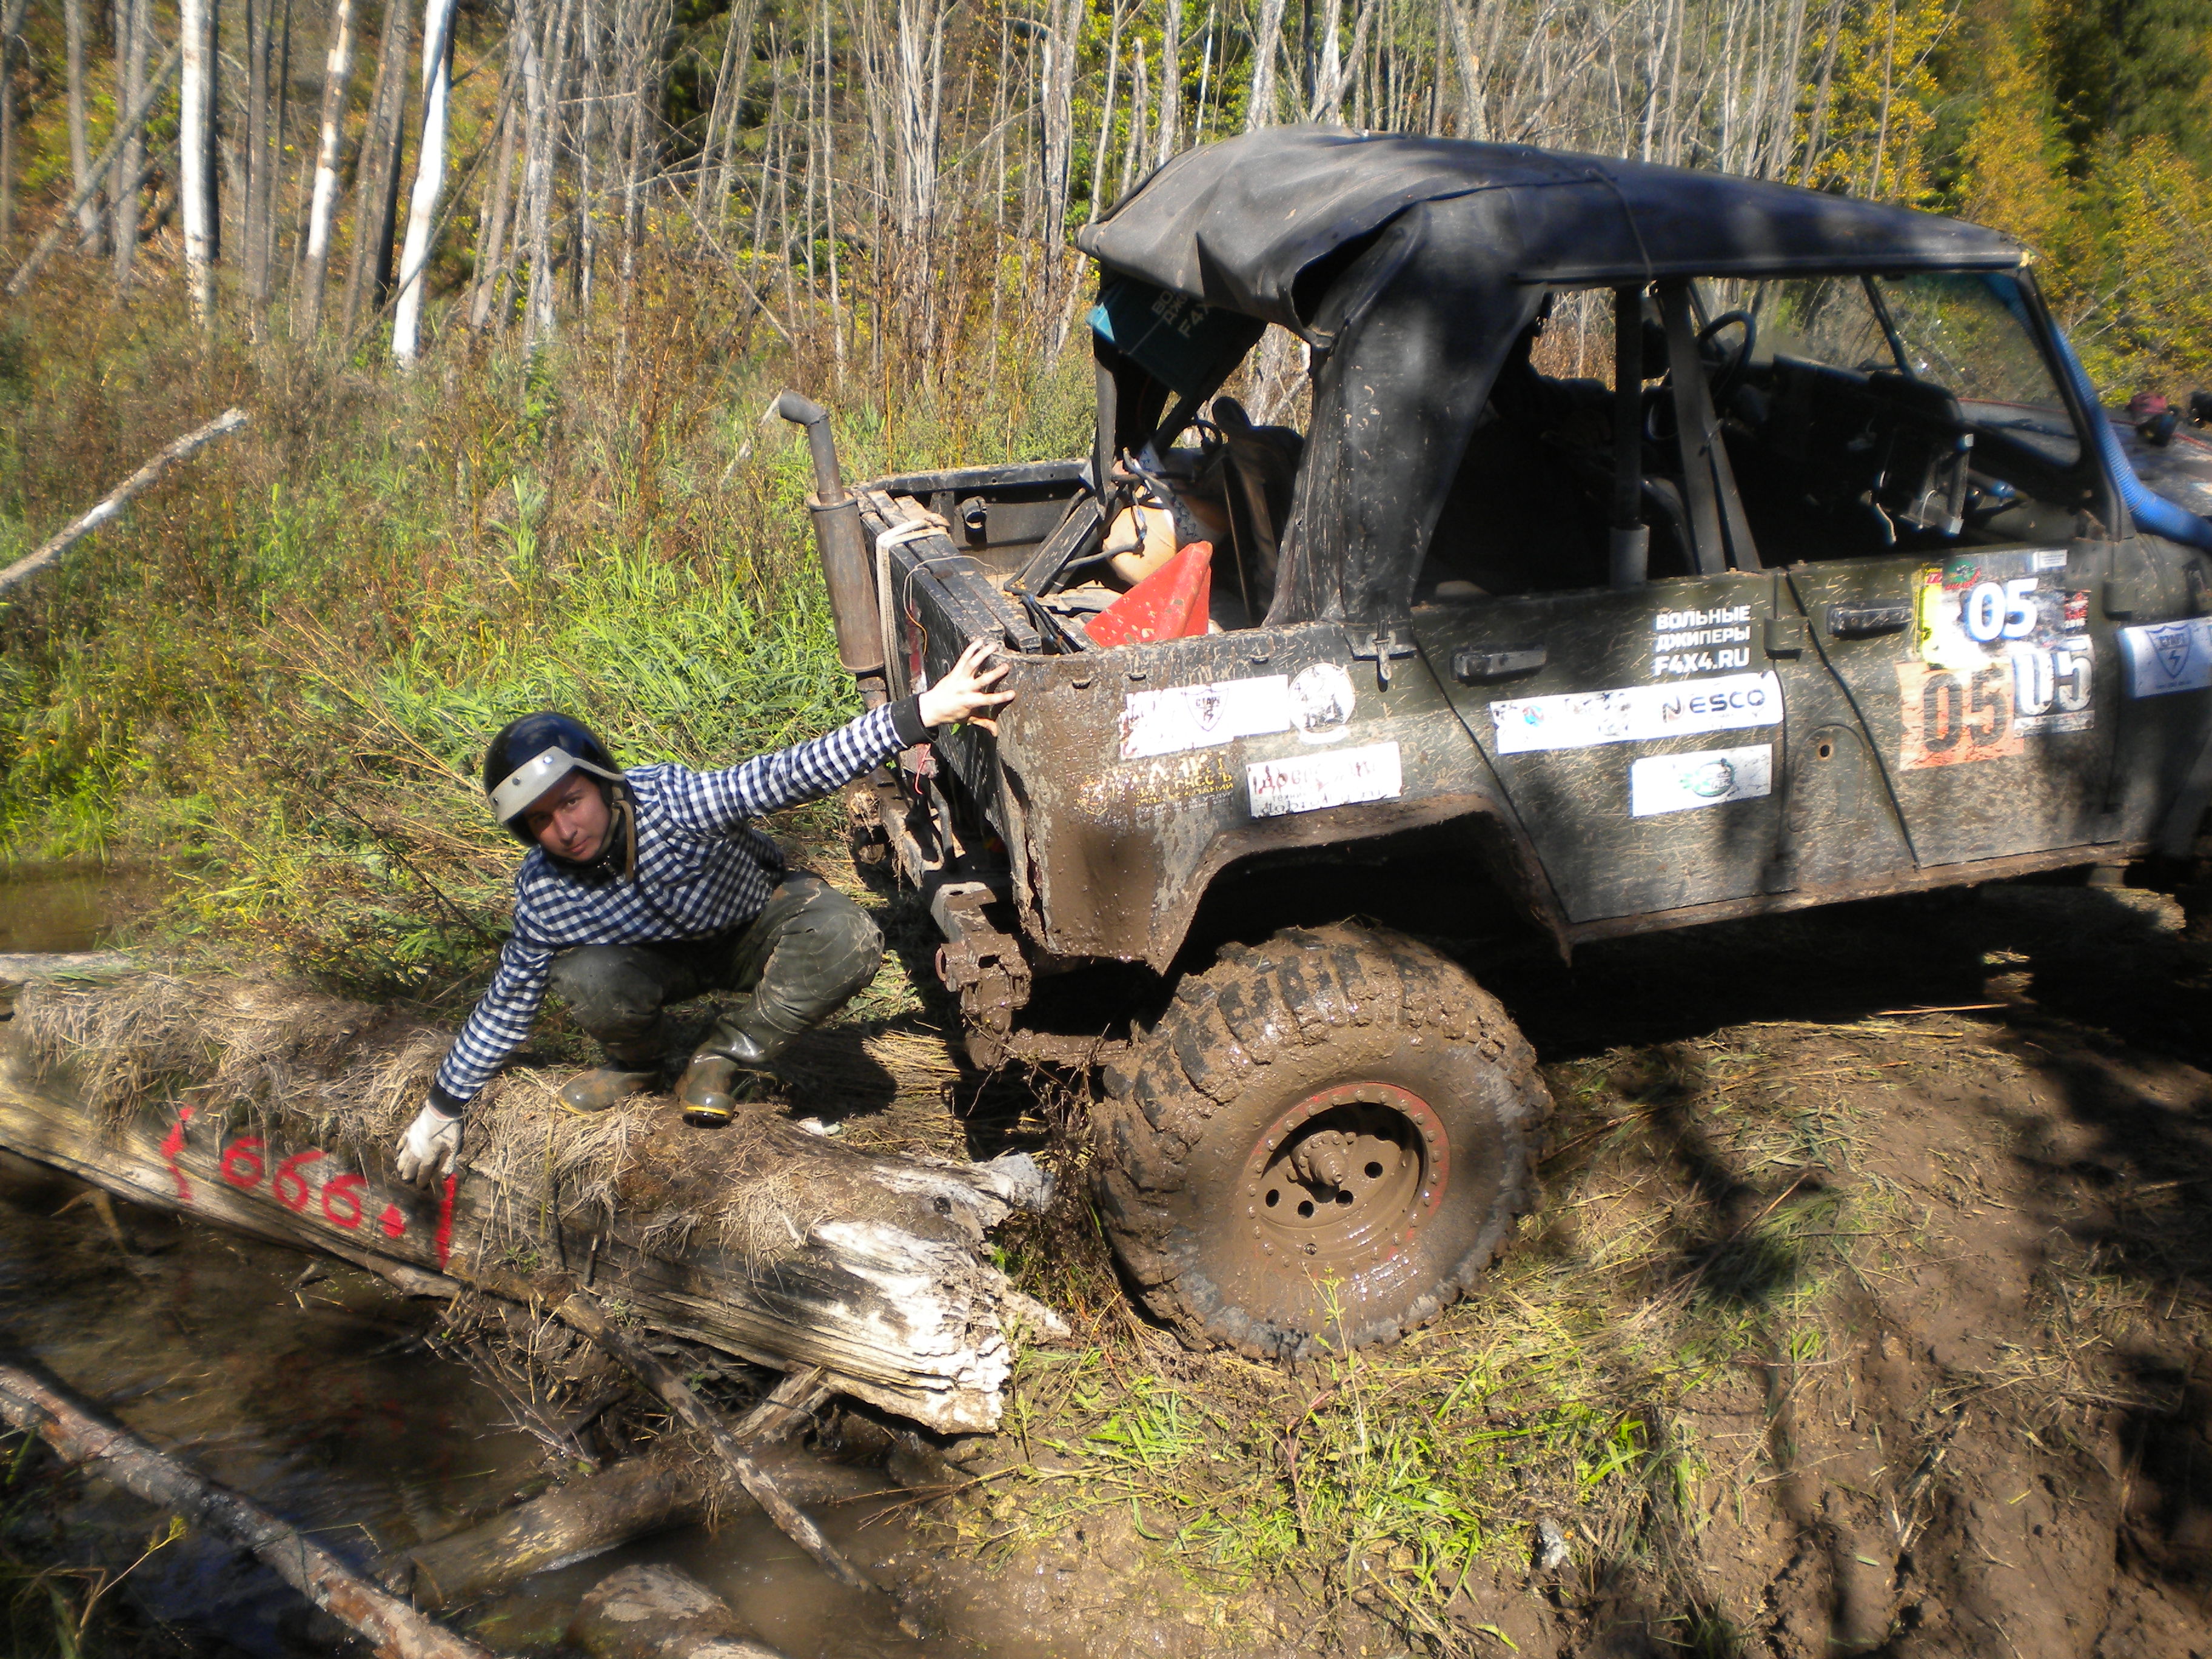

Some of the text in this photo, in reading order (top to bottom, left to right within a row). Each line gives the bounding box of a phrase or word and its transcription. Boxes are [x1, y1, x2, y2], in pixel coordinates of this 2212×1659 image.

[1656, 605, 1751, 631] ВОЛЬНЫЕ
[1967, 577, 2039, 642] 05
[1655, 626, 1751, 652] ДЖИПЕРЫ
[1654, 647, 1750, 677] F4X4.RU
[1662, 689, 1766, 723] NESCO
[1923, 667, 2008, 753] 05
